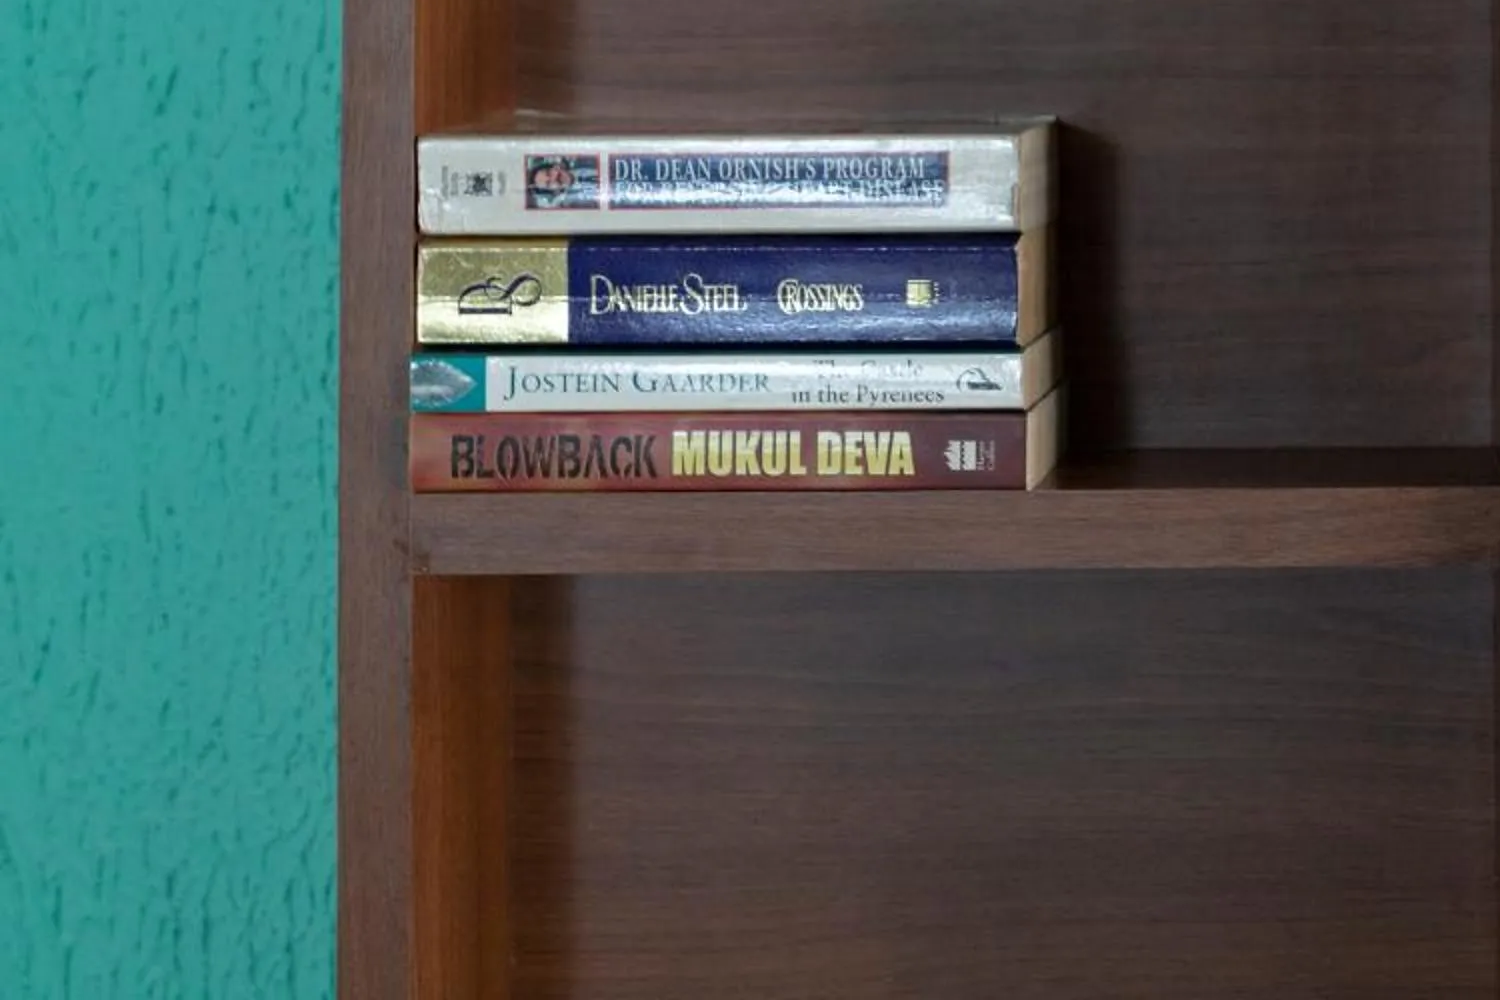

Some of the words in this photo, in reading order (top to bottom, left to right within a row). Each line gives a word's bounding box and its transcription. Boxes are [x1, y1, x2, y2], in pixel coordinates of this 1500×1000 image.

[614, 159, 649, 181] DR.
[655, 158, 711, 181] DEAN
[718, 157, 817, 180] ORNISH'S
[823, 156, 926, 180] PROGRAM
[503, 366, 621, 401] JOSTEIN
[631, 371, 771, 395] GAARDER
[817, 384, 849, 404] the
[857, 383, 945, 408] Pyrenees
[451, 434, 658, 480] BLOWBACK
[672, 430, 808, 477] MUKUL
[816, 430, 916, 477] DEVA
